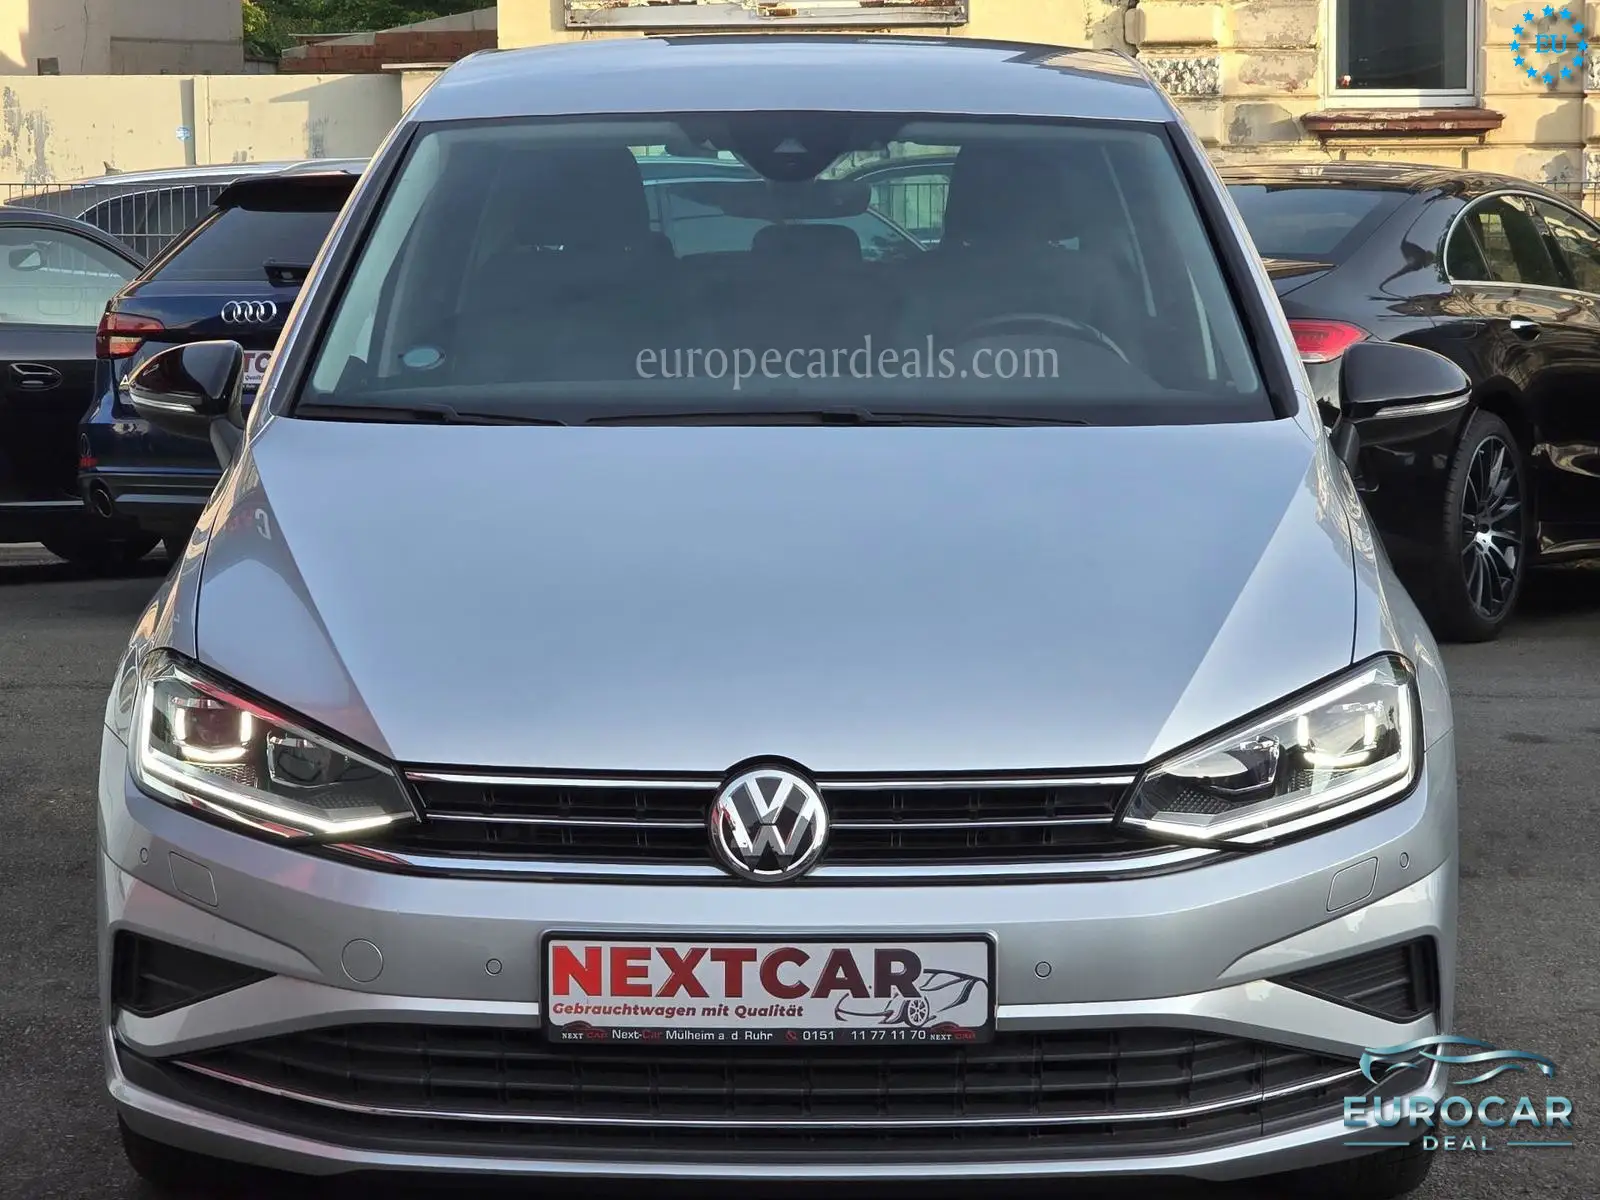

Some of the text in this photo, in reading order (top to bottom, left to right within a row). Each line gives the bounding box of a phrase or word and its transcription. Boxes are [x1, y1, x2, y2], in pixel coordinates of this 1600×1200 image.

[552, 946, 922, 999] NEXTCAR
[552, 1002, 804, 1019] Gebrauchtwagen mit Qualität
[561, 1032, 584, 1040] NEXT
[665, 1029, 715, 1040] Mülheim
[744, 1030, 773, 1040] Ruhr
[802, 1030, 834, 1041] 0151
[851, 1030, 866, 1041] 11
[870, 1030, 886, 1041] 77
[890, 1030, 905, 1041] 11
[910, 1030, 926, 1040] 70
